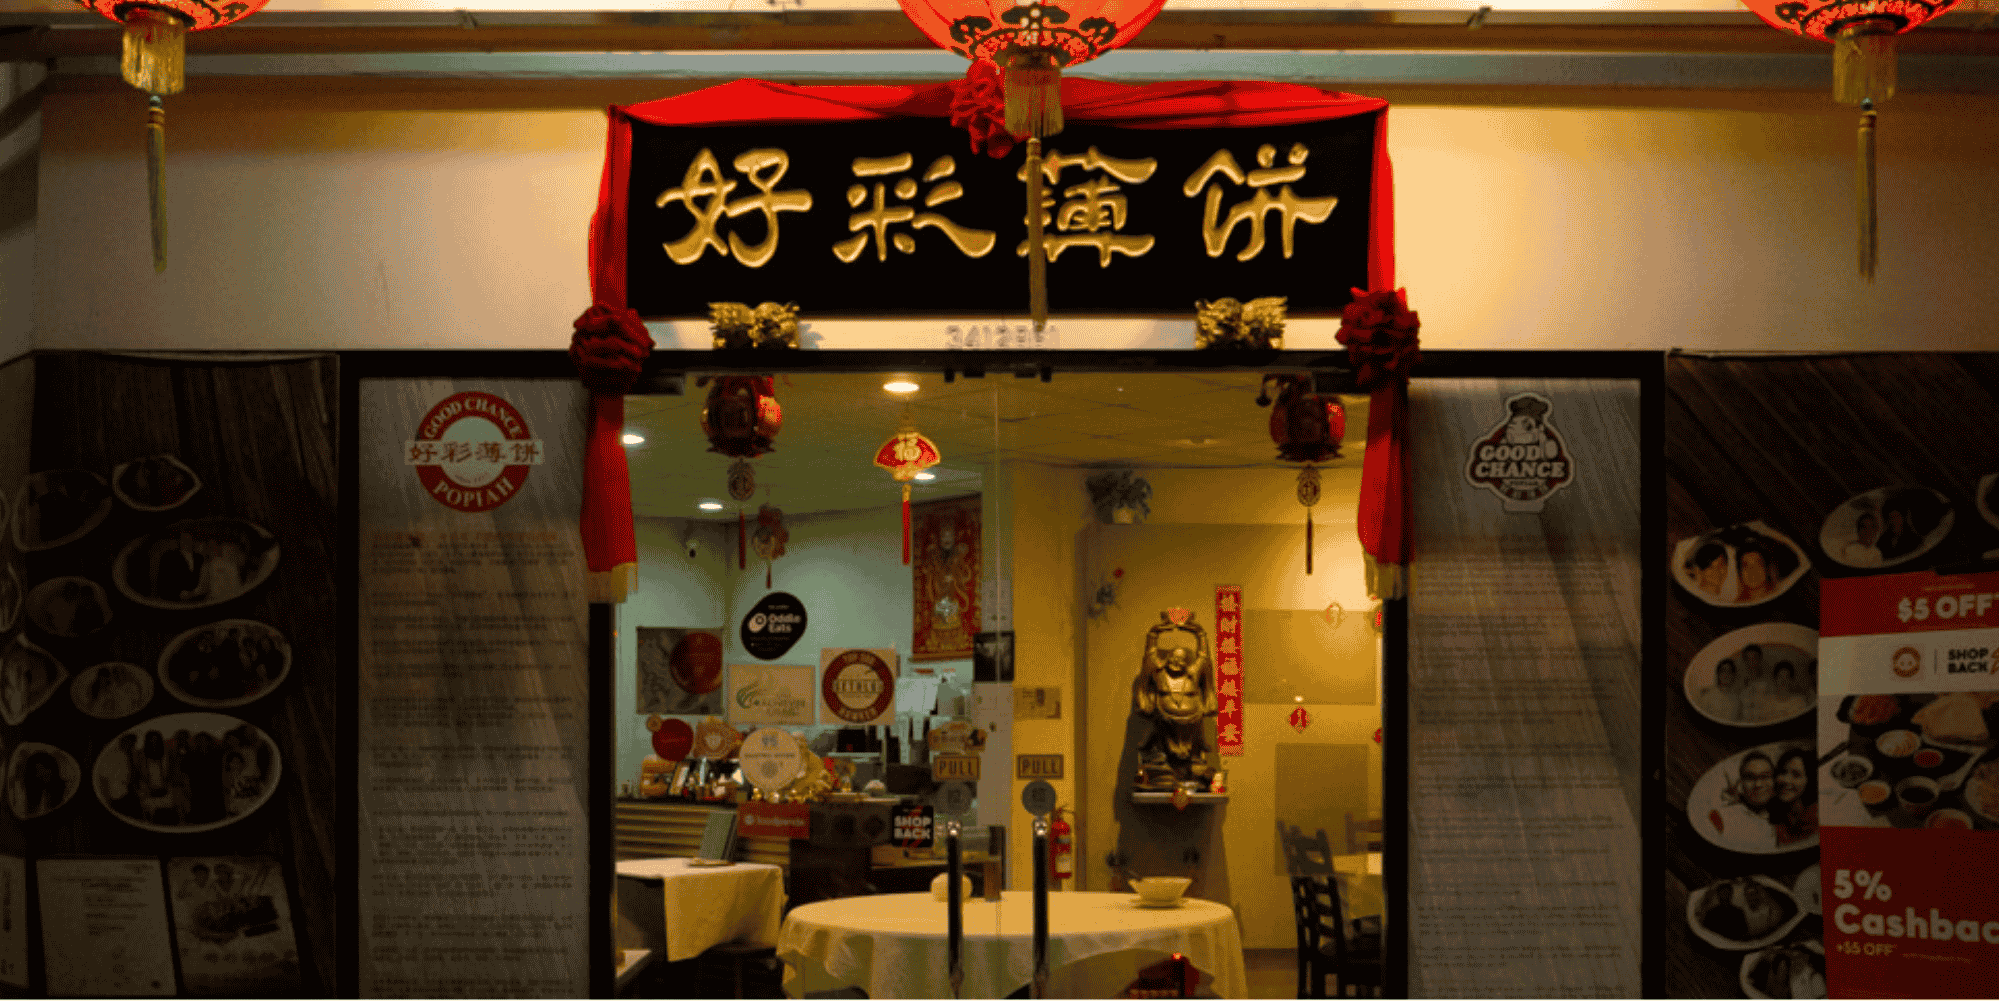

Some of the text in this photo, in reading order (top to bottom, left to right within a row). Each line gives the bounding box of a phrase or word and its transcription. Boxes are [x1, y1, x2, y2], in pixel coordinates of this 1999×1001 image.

[423, 397, 522, 438] GOOD CHANCE
[1479, 444, 1543, 461] GOOD
[1474, 461, 1566, 478] CHANCE
[433, 476, 515, 507] POPIAH
[1897, 597, 1930, 623] $5
[768, 613, 802, 623] Oddle
[768, 624, 792, 633] Eats
[1948, 647, 1988, 660] SHOP
[1948, 661, 1988, 674] BACK
[939, 760, 975, 775] PULL
[1022, 759, 1058, 774] PULL
[894, 816, 931, 827] SHOP
[894, 828, 931, 839] BACK
[1833, 869, 1892, 902] 5%
[1836, 941, 1861, 955] +$5
